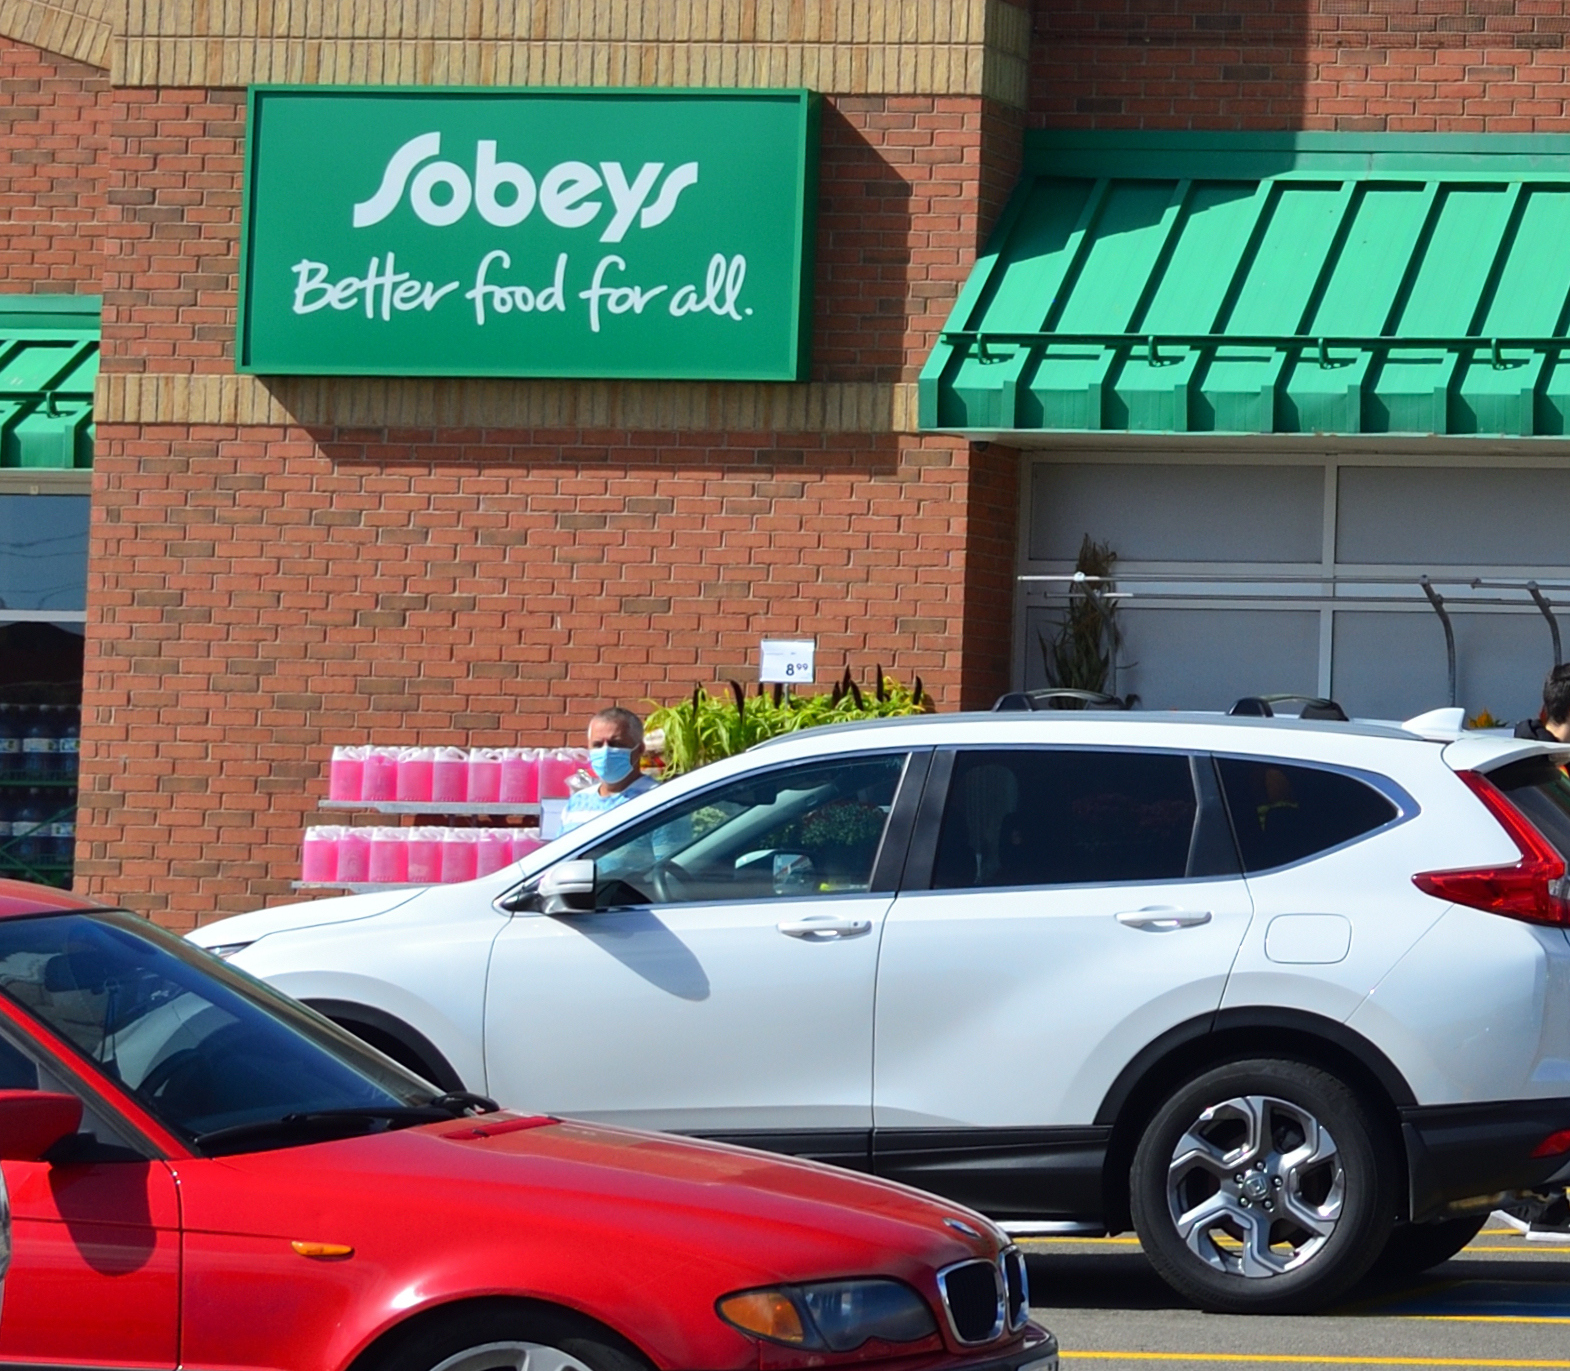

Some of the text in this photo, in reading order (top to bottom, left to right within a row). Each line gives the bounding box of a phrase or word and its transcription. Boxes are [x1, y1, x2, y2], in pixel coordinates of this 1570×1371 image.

[352, 130, 699, 243] Sobeys
[291, 249, 754, 333] Better food for all.
